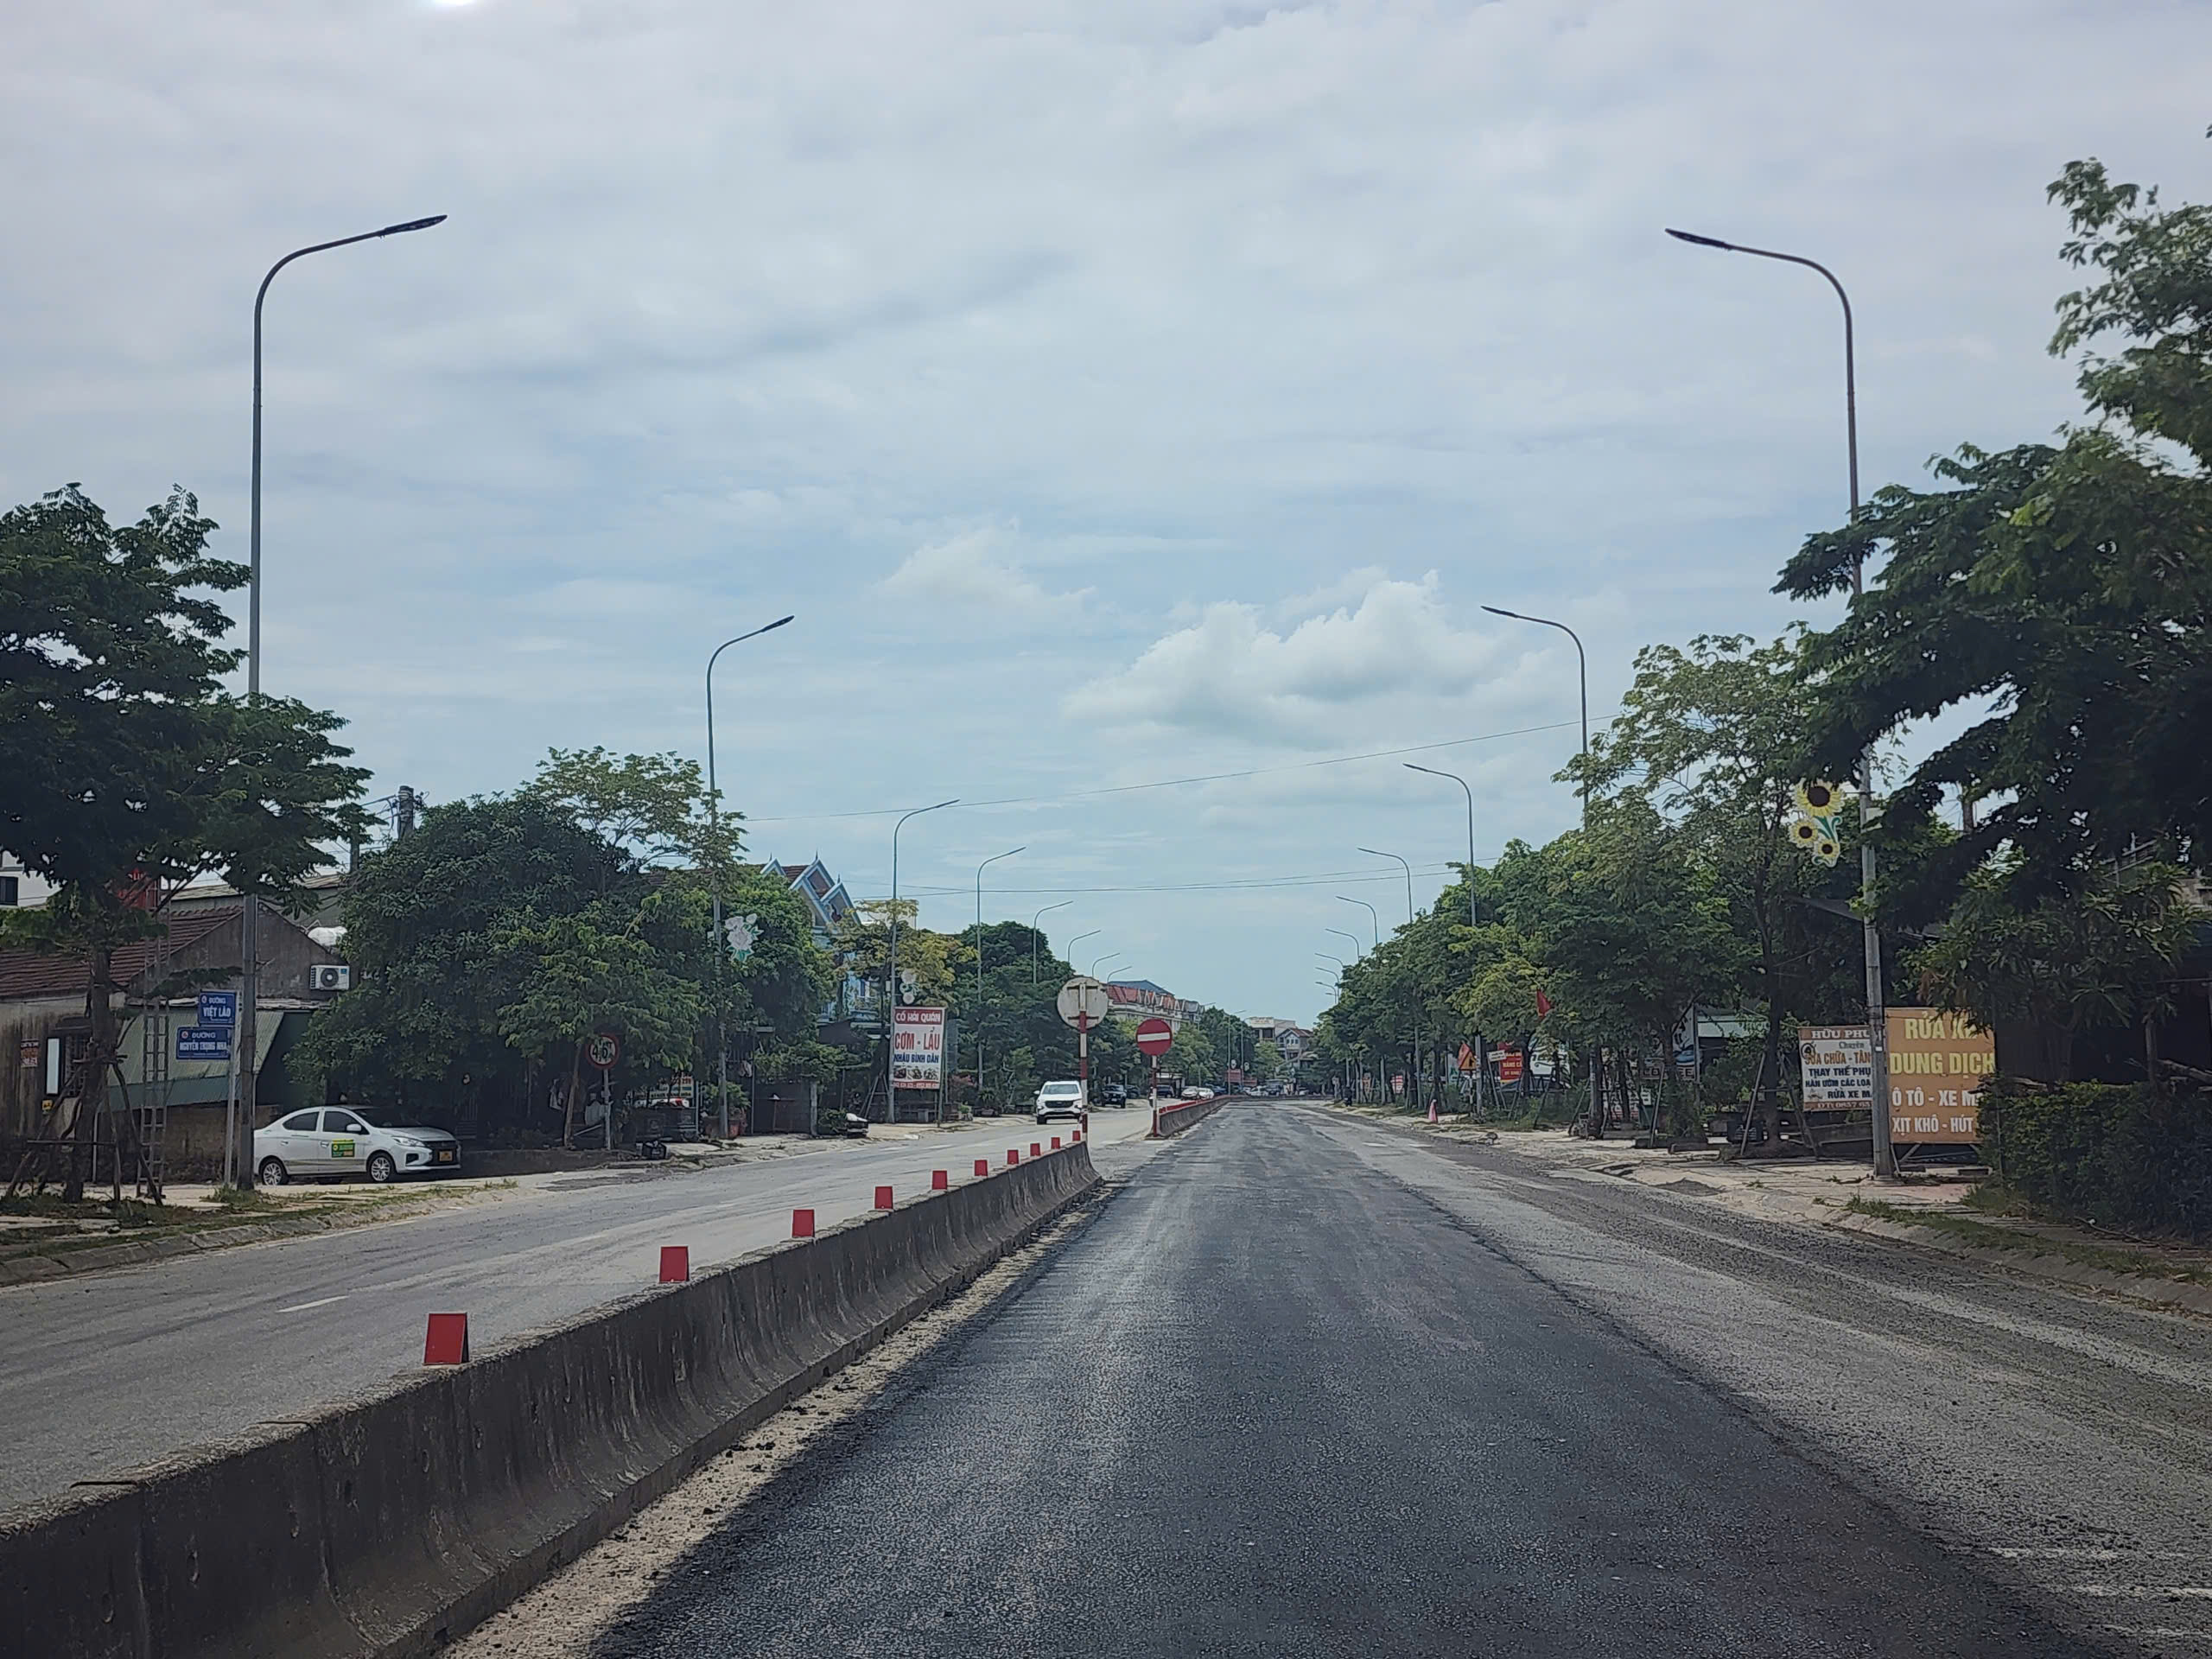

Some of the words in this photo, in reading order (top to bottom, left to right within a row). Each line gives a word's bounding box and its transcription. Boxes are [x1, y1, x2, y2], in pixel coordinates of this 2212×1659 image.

[1811, 1028, 1840, 1039] HỮU
[1904, 1011, 1945, 1039] RỬA
[894, 1031, 915, 1051] CƠM
[923, 1027, 940, 1051] LẨU
[1823, 1050, 1847, 1065] CHỮA
[1890, 1052, 1943, 1074] DUNG
[1948, 1052, 1995, 1079] DỊCH
[1808, 1067, 1830, 1077] THAY
[1833, 1065, 1851, 1076] THẾ
[1840, 1078, 1855, 1087] CÁC
[1827, 1089, 1847, 1099] RỬA
[1891, 1086, 1902, 1107] Ô
[1905, 1086, 1924, 1107] TÔ
[1938, 1090, 1958, 1107] XE
[1892, 1116, 1911, 1136] XỊT
[1914, 1114, 1939, 1133] KHÔ
[1950, 1114, 1974, 1133] HÚT
